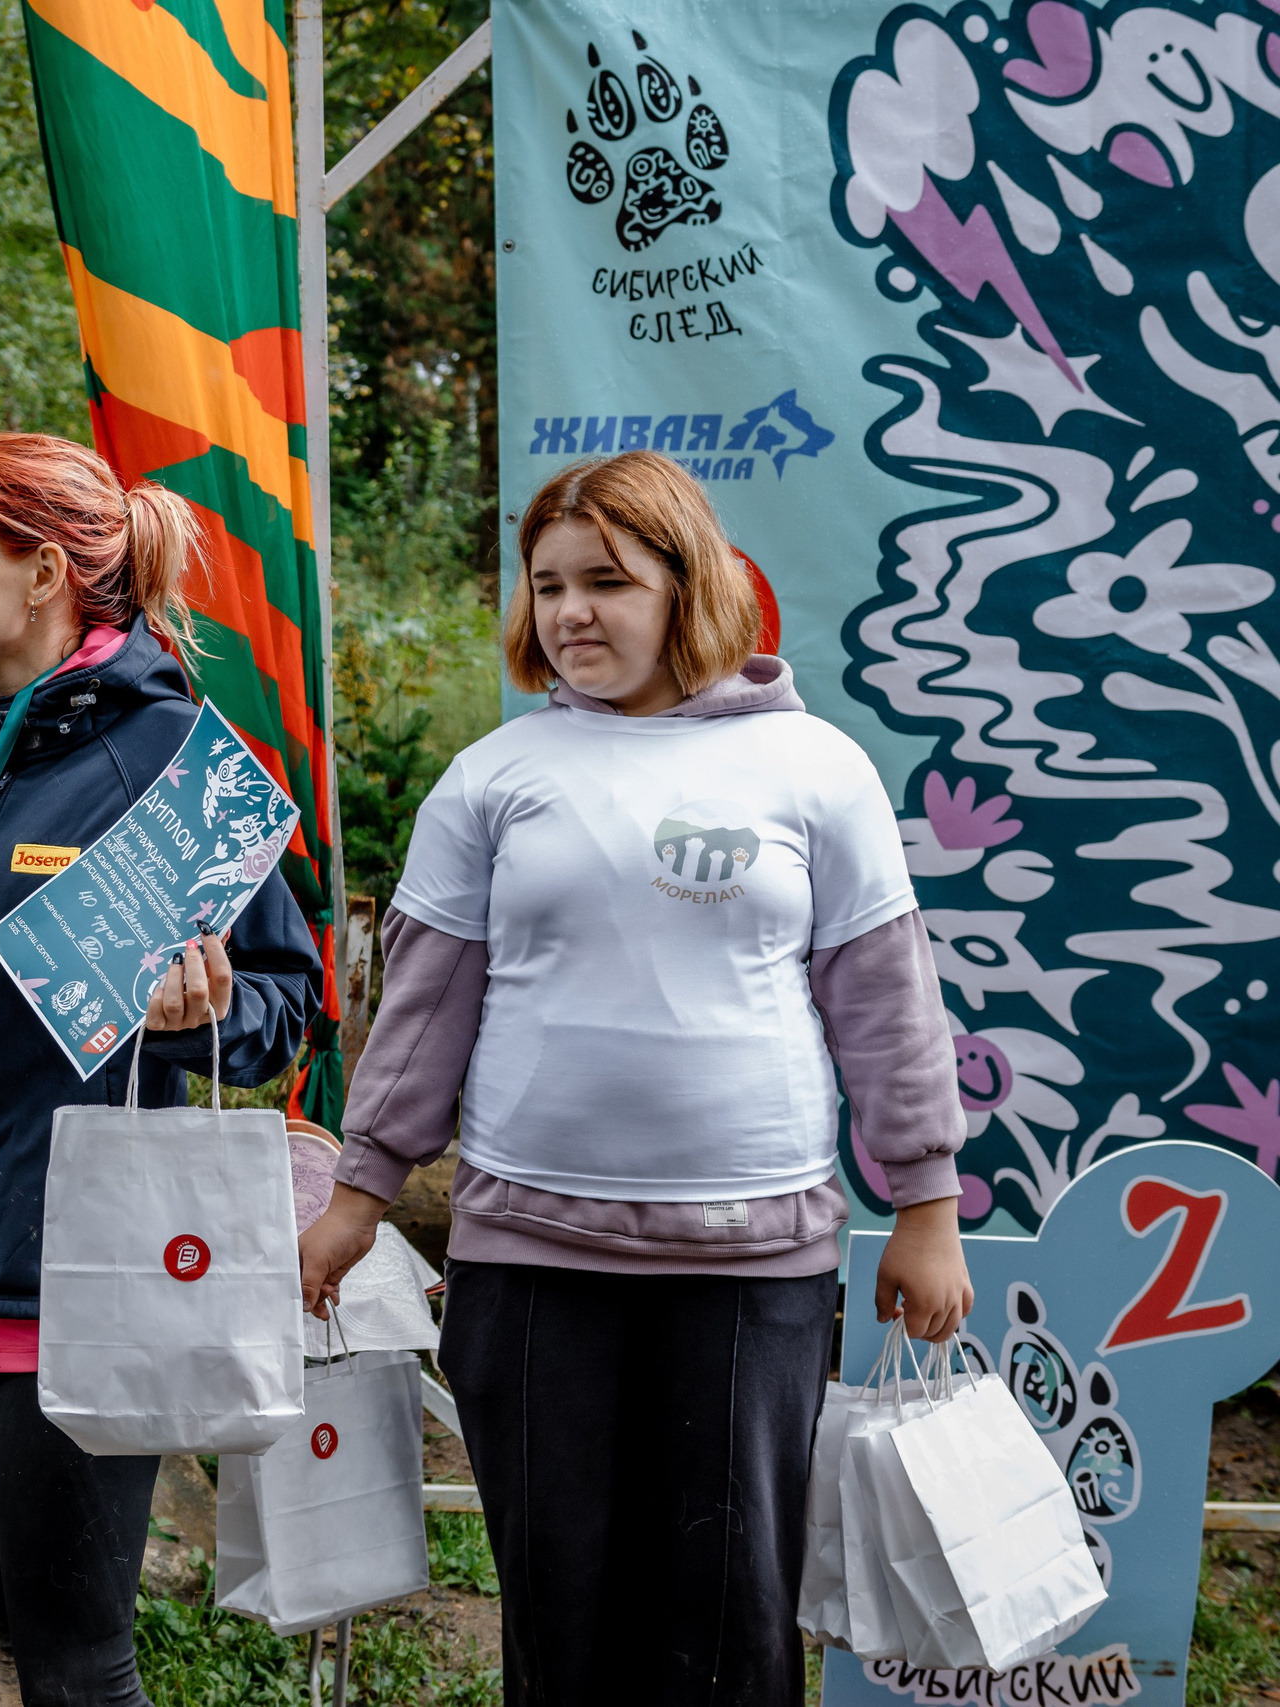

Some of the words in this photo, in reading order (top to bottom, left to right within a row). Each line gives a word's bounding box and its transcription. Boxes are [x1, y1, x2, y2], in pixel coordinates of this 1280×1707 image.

[592, 243, 764, 302] СИБИРСКИЙ
[630, 302, 742, 343] СЛЁД
[529, 414, 723, 454] ЖИВАЯ
[140, 790, 200, 861] ДИПЛОМ
[15, 851, 71, 867] Josera
[113, 854, 134, 877] МЕСТО
[130, 873, 138, 882] В
[124, 815, 179, 885] НАГРАЖДАЕТСЯ
[79, 858, 117, 905] ДИСЦИПЛИНА
[107, 869, 129, 894] РАУНД
[651, 876, 745, 904] МОРЕЛАП
[8, 920, 21, 936] 2025
[40, 894, 64, 923] ГЛАВНЫЙ
[59, 920, 77, 940] СУДЬЯ
[89, 962, 114, 992] ВИКТОРИЯ
[35, 943, 56, 966] СЕКТОР
[1100, 1178, 1249, 1352] 2
